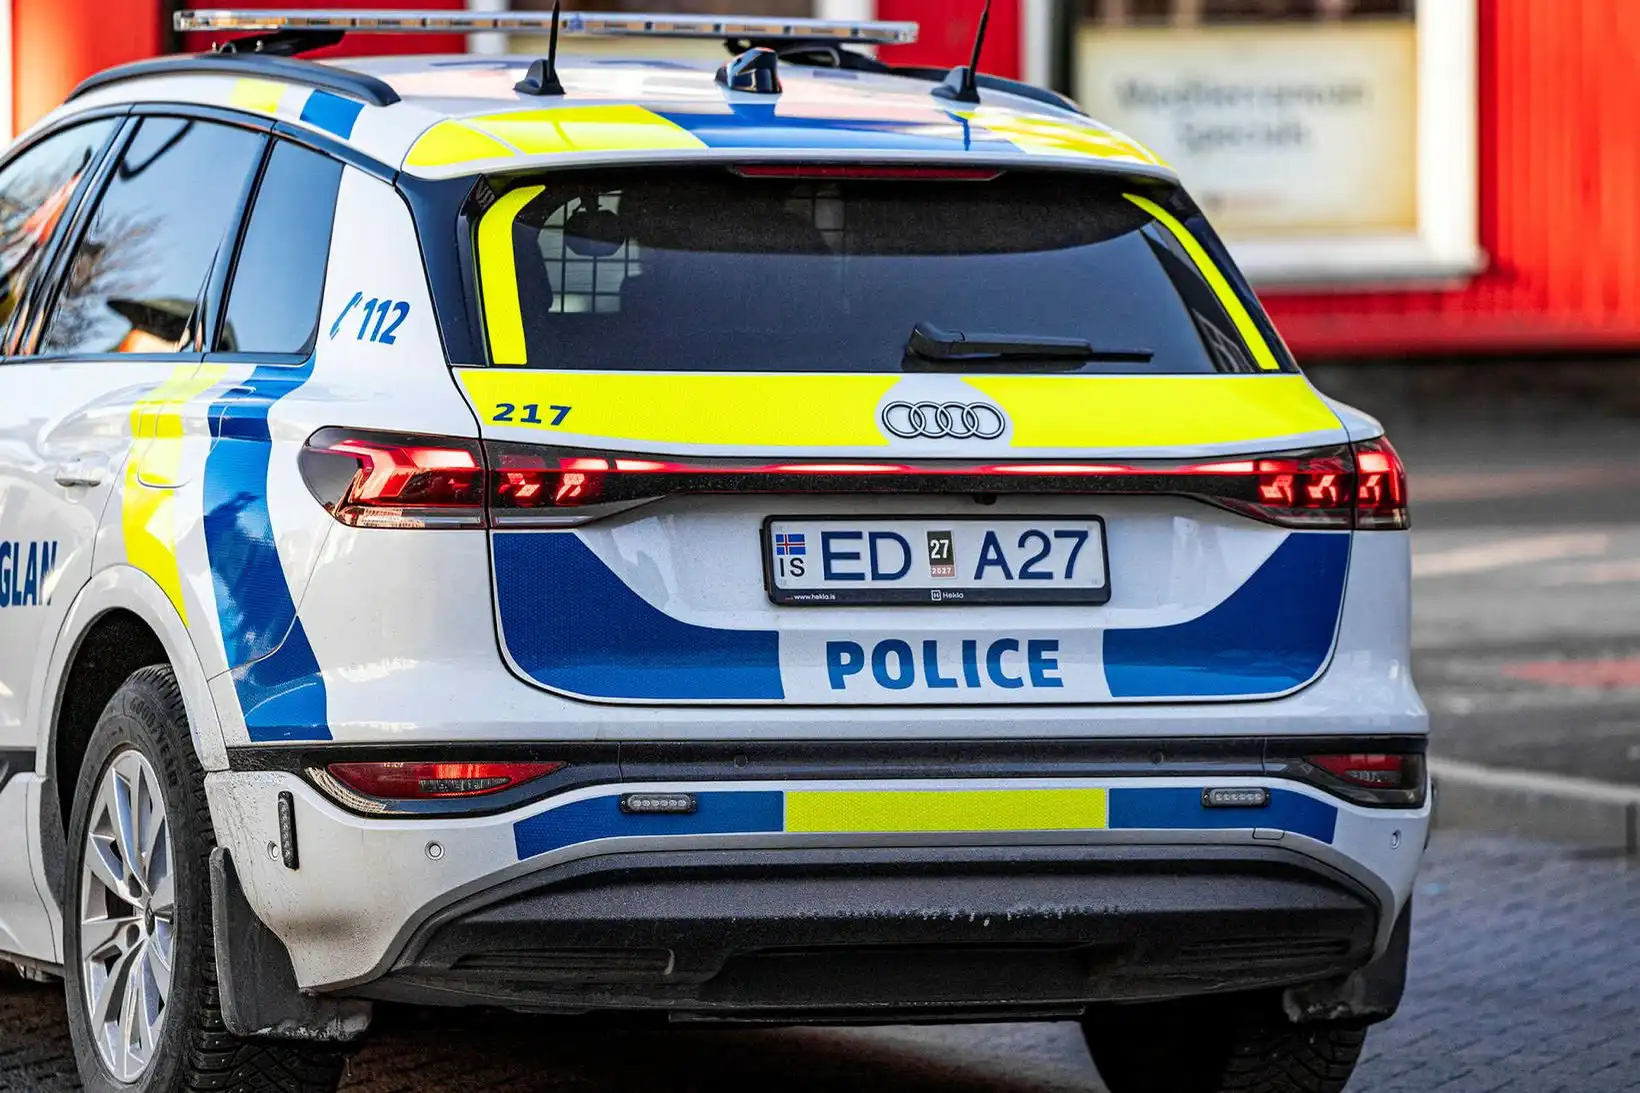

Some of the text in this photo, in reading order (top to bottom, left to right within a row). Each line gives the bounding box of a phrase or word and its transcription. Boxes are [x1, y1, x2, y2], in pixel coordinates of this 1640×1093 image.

[357, 298, 410, 345] 112
[492, 403, 572, 426] 217
[821, 529, 1089, 581] ED A27
[930, 539, 949, 559] 27
[779, 557, 806, 578] IS
[931, 567, 952, 575] 2027
[826, 638, 1064, 690] POLICE
